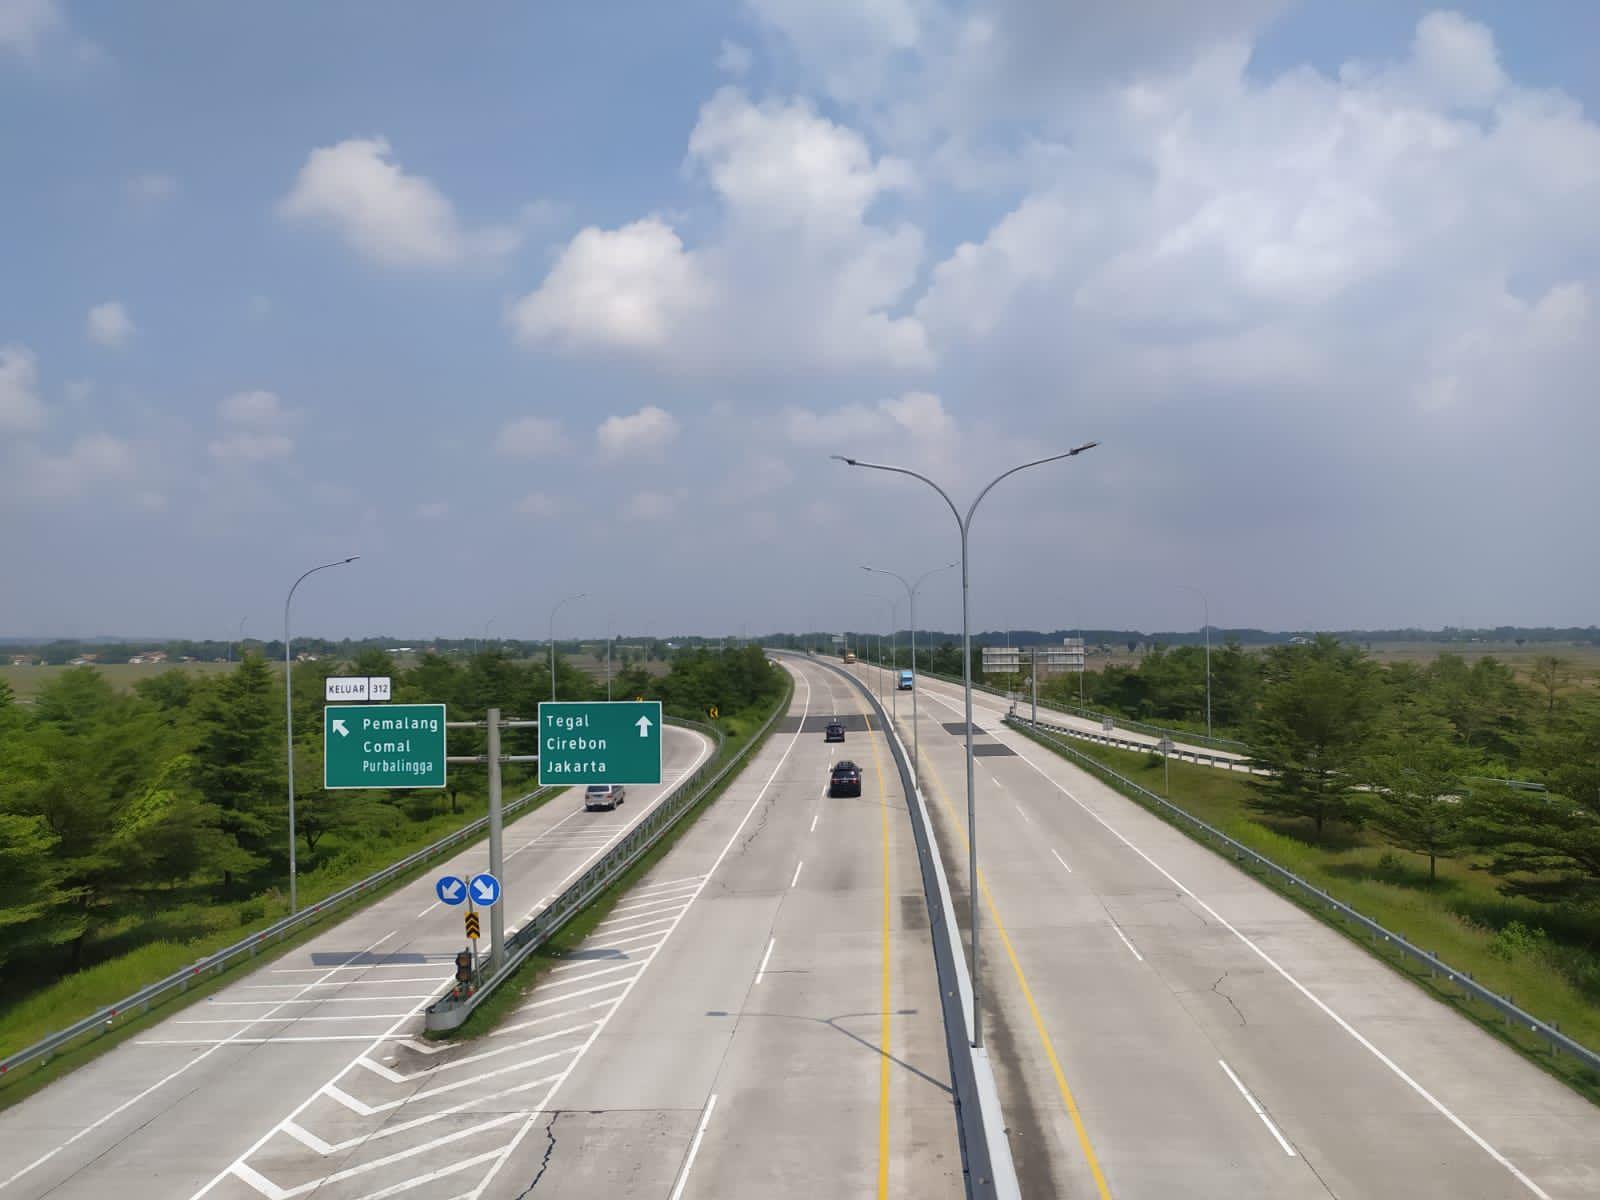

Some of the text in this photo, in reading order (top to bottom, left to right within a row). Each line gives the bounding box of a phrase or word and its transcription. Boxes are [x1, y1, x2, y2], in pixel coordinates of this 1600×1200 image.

[329, 684, 365, 694] KELUAR
[373, 684, 388, 694] 312
[363, 717, 438, 732] Pemalang
[547, 715, 589, 729] Tegal
[363, 740, 410, 753] Comal
[546, 736, 607, 750] Cirebon
[363, 759, 433, 775] Purbalingga
[546, 760, 606, 773] Jakarta
